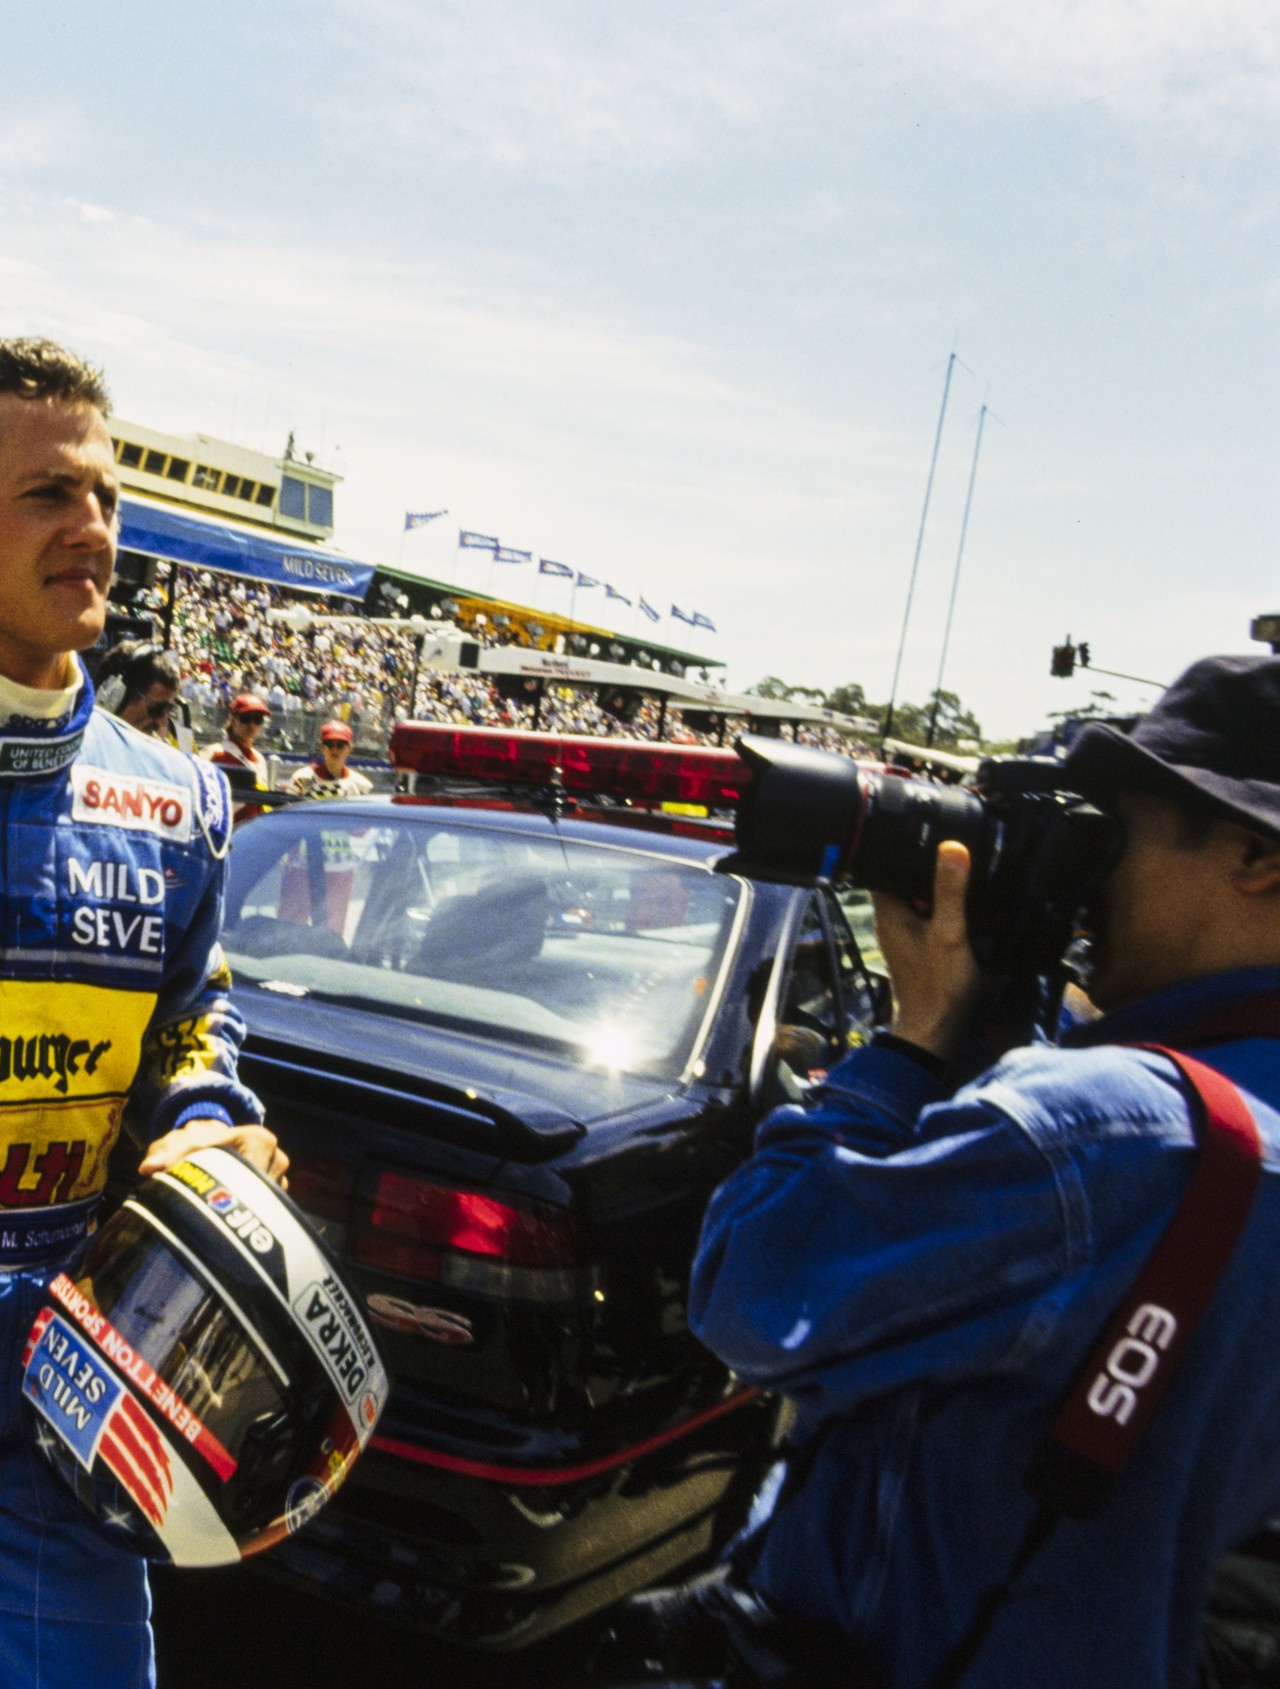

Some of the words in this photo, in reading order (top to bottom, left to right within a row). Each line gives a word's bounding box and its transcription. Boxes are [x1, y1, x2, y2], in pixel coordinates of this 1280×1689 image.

[282, 556, 314, 579] MILD
[314, 563, 355, 586] SEVEN
[10, 748, 55, 759] UNITED
[12, 760, 28, 770] OF
[82, 779, 183, 827] SANYO
[67, 857, 165, 905] MILD
[72, 906, 165, 953] SEVE
[225, 1208, 274, 1254] elf
[42, 1326, 107, 1404] SEVEN
[305, 1289, 365, 1396] DEKRA
[1086, 1303, 1178, 1427] EOS
[39, 1362, 92, 1431] MILD
[101, 1332, 203, 1442] BENETTON
